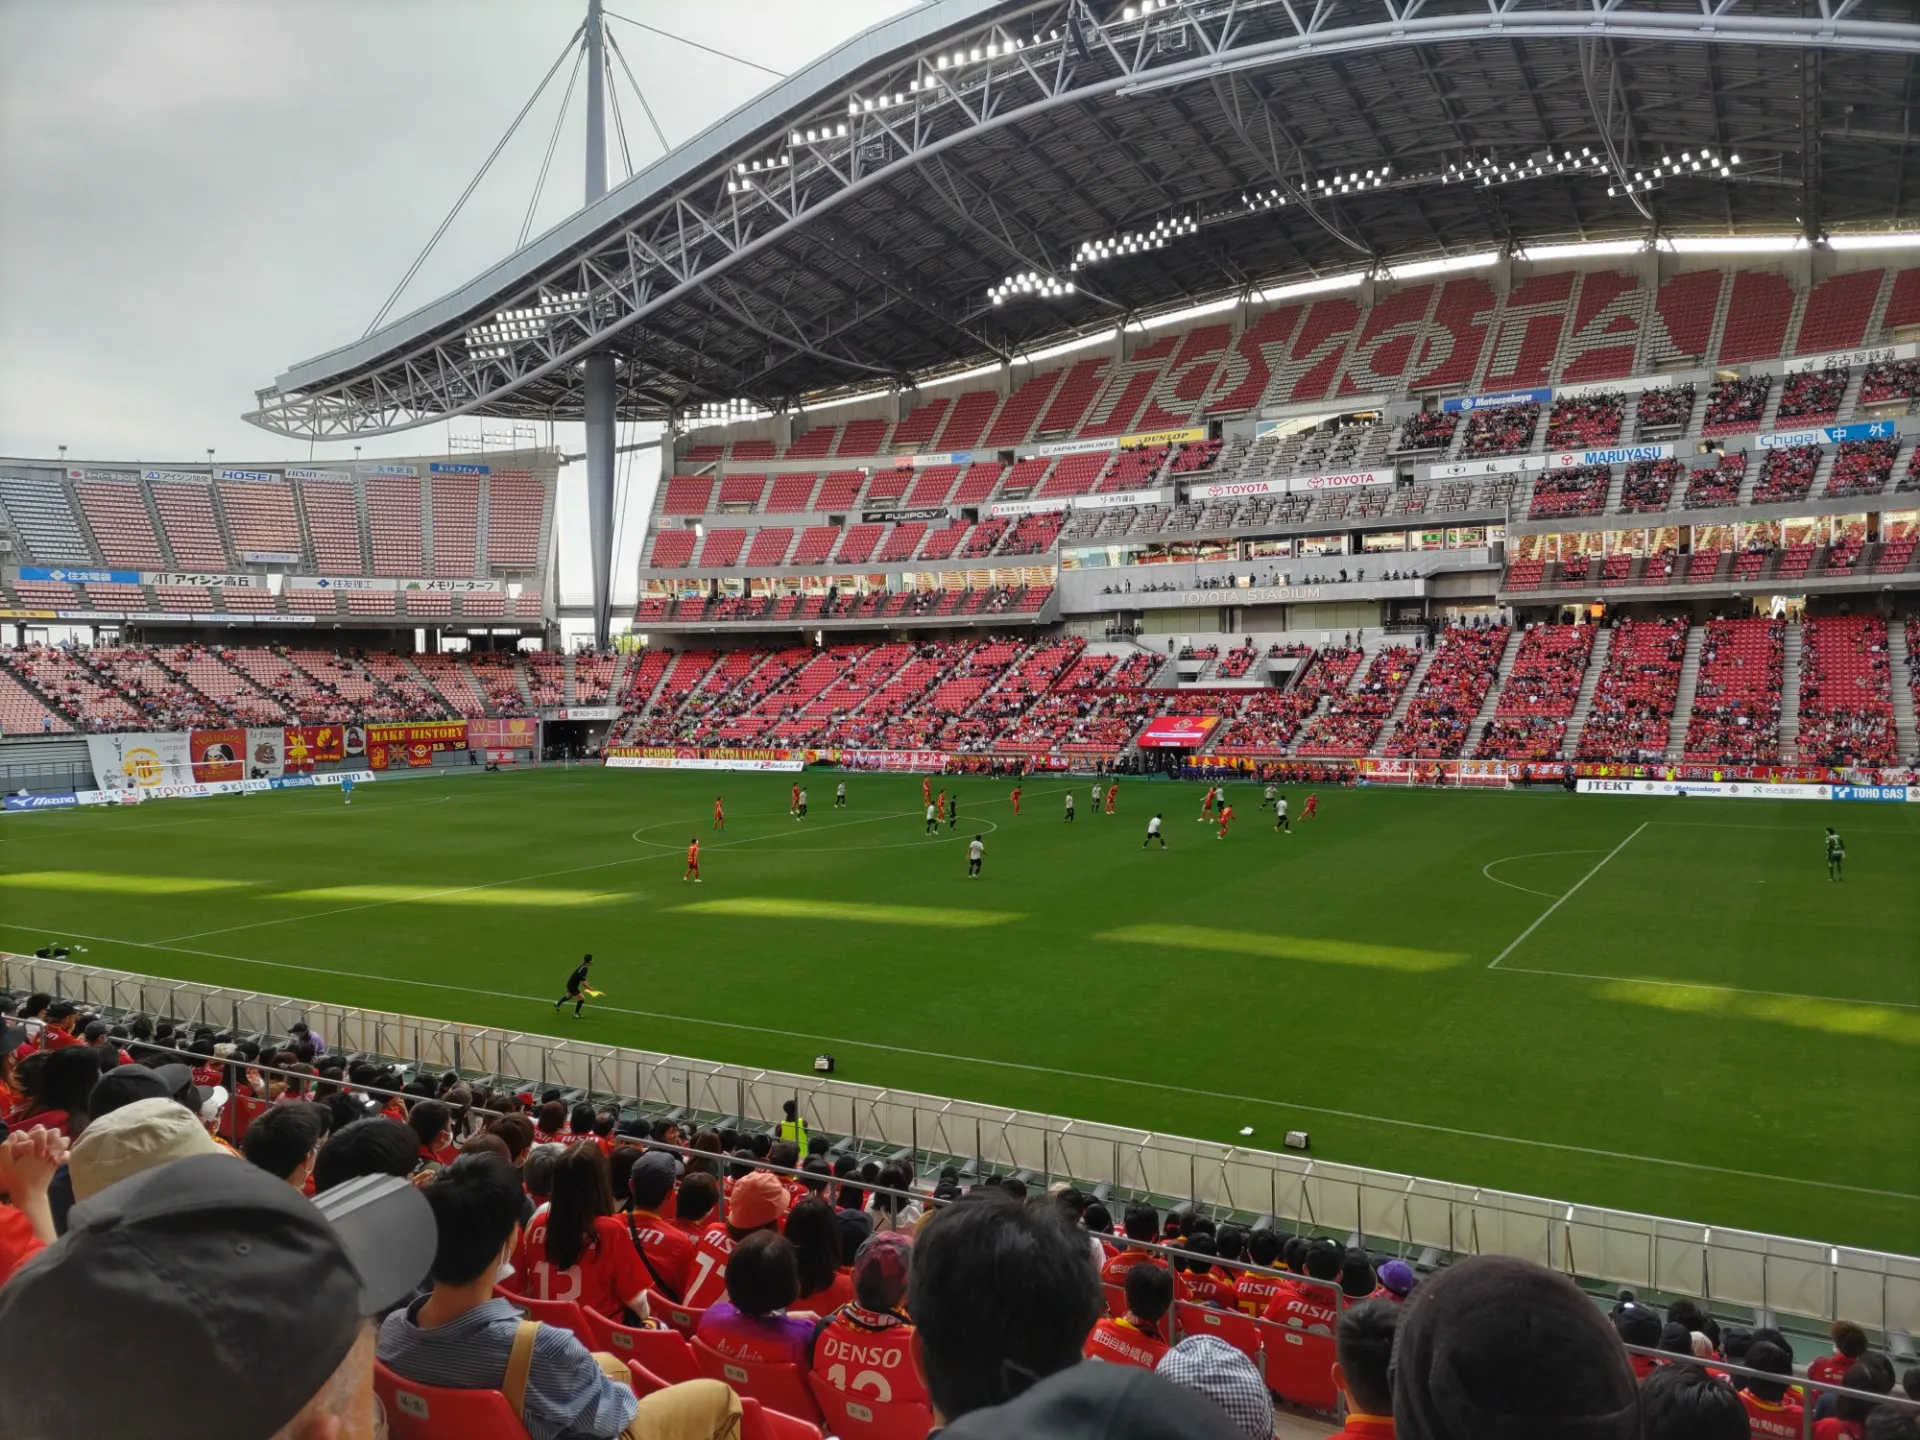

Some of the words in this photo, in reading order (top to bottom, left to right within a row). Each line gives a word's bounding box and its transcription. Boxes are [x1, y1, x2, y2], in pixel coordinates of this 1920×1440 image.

[1824, 348, 1897, 368] 名古屋鉄道
[1475, 394, 1533, 407] Matsuzakaya
[1143, 432, 1189, 443] DUNLOP
[1760, 430, 1818, 446] Chugai
[1052, 444, 1077, 452] JAPAN
[1078, 441, 1114, 450] AIRLINES
[1585, 446, 1662, 464] MARUYASU
[221, 471, 273, 482] HOSEI
[287, 470, 317, 479] AISIN
[1327, 474, 1374, 486] TOYOTA
[1226, 483, 1269, 495] TOYOTA
[885, 511, 938, 520] FUJIPOLY
[67, 571, 111, 582] 住友電装
[175, 575, 249, 587] アイシン高丘
[333, 580, 373, 589] 住友理工
[426, 581, 494, 591] メモリーターフ
[1180, 591, 1239, 604] TOYOTA
[1247, 587, 1321, 601] STADIUM
[371, 730, 406, 742] MAKE
[411, 727, 464, 740] HISTORY
[156, 784, 208, 797] TOYOTA
[1587, 780, 1633, 791] JTEKT
[1674, 785, 1721, 793] Matsuzakaya
[1852, 787, 1880, 798] TOHO
[1882, 788, 1904, 799] GAS
[823, 1336, 903, 1370] DENSO
